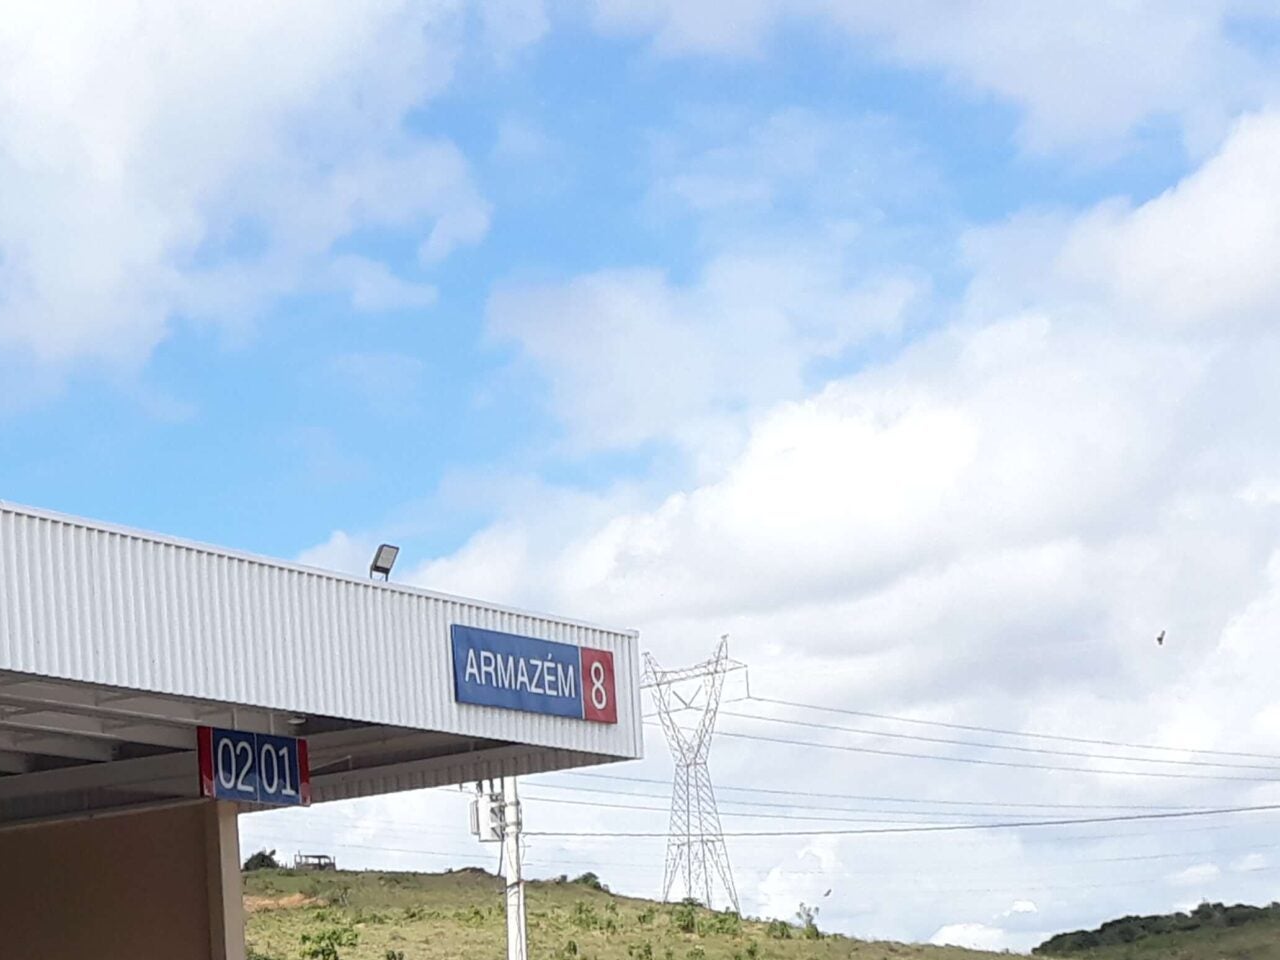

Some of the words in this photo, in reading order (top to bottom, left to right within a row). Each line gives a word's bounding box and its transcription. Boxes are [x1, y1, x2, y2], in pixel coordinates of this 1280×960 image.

[465, 648, 576, 698] ARMAZÉM
[591, 661, 607, 710] 8
[217, 738, 254, 792] 02
[261, 744, 296, 795] 01
